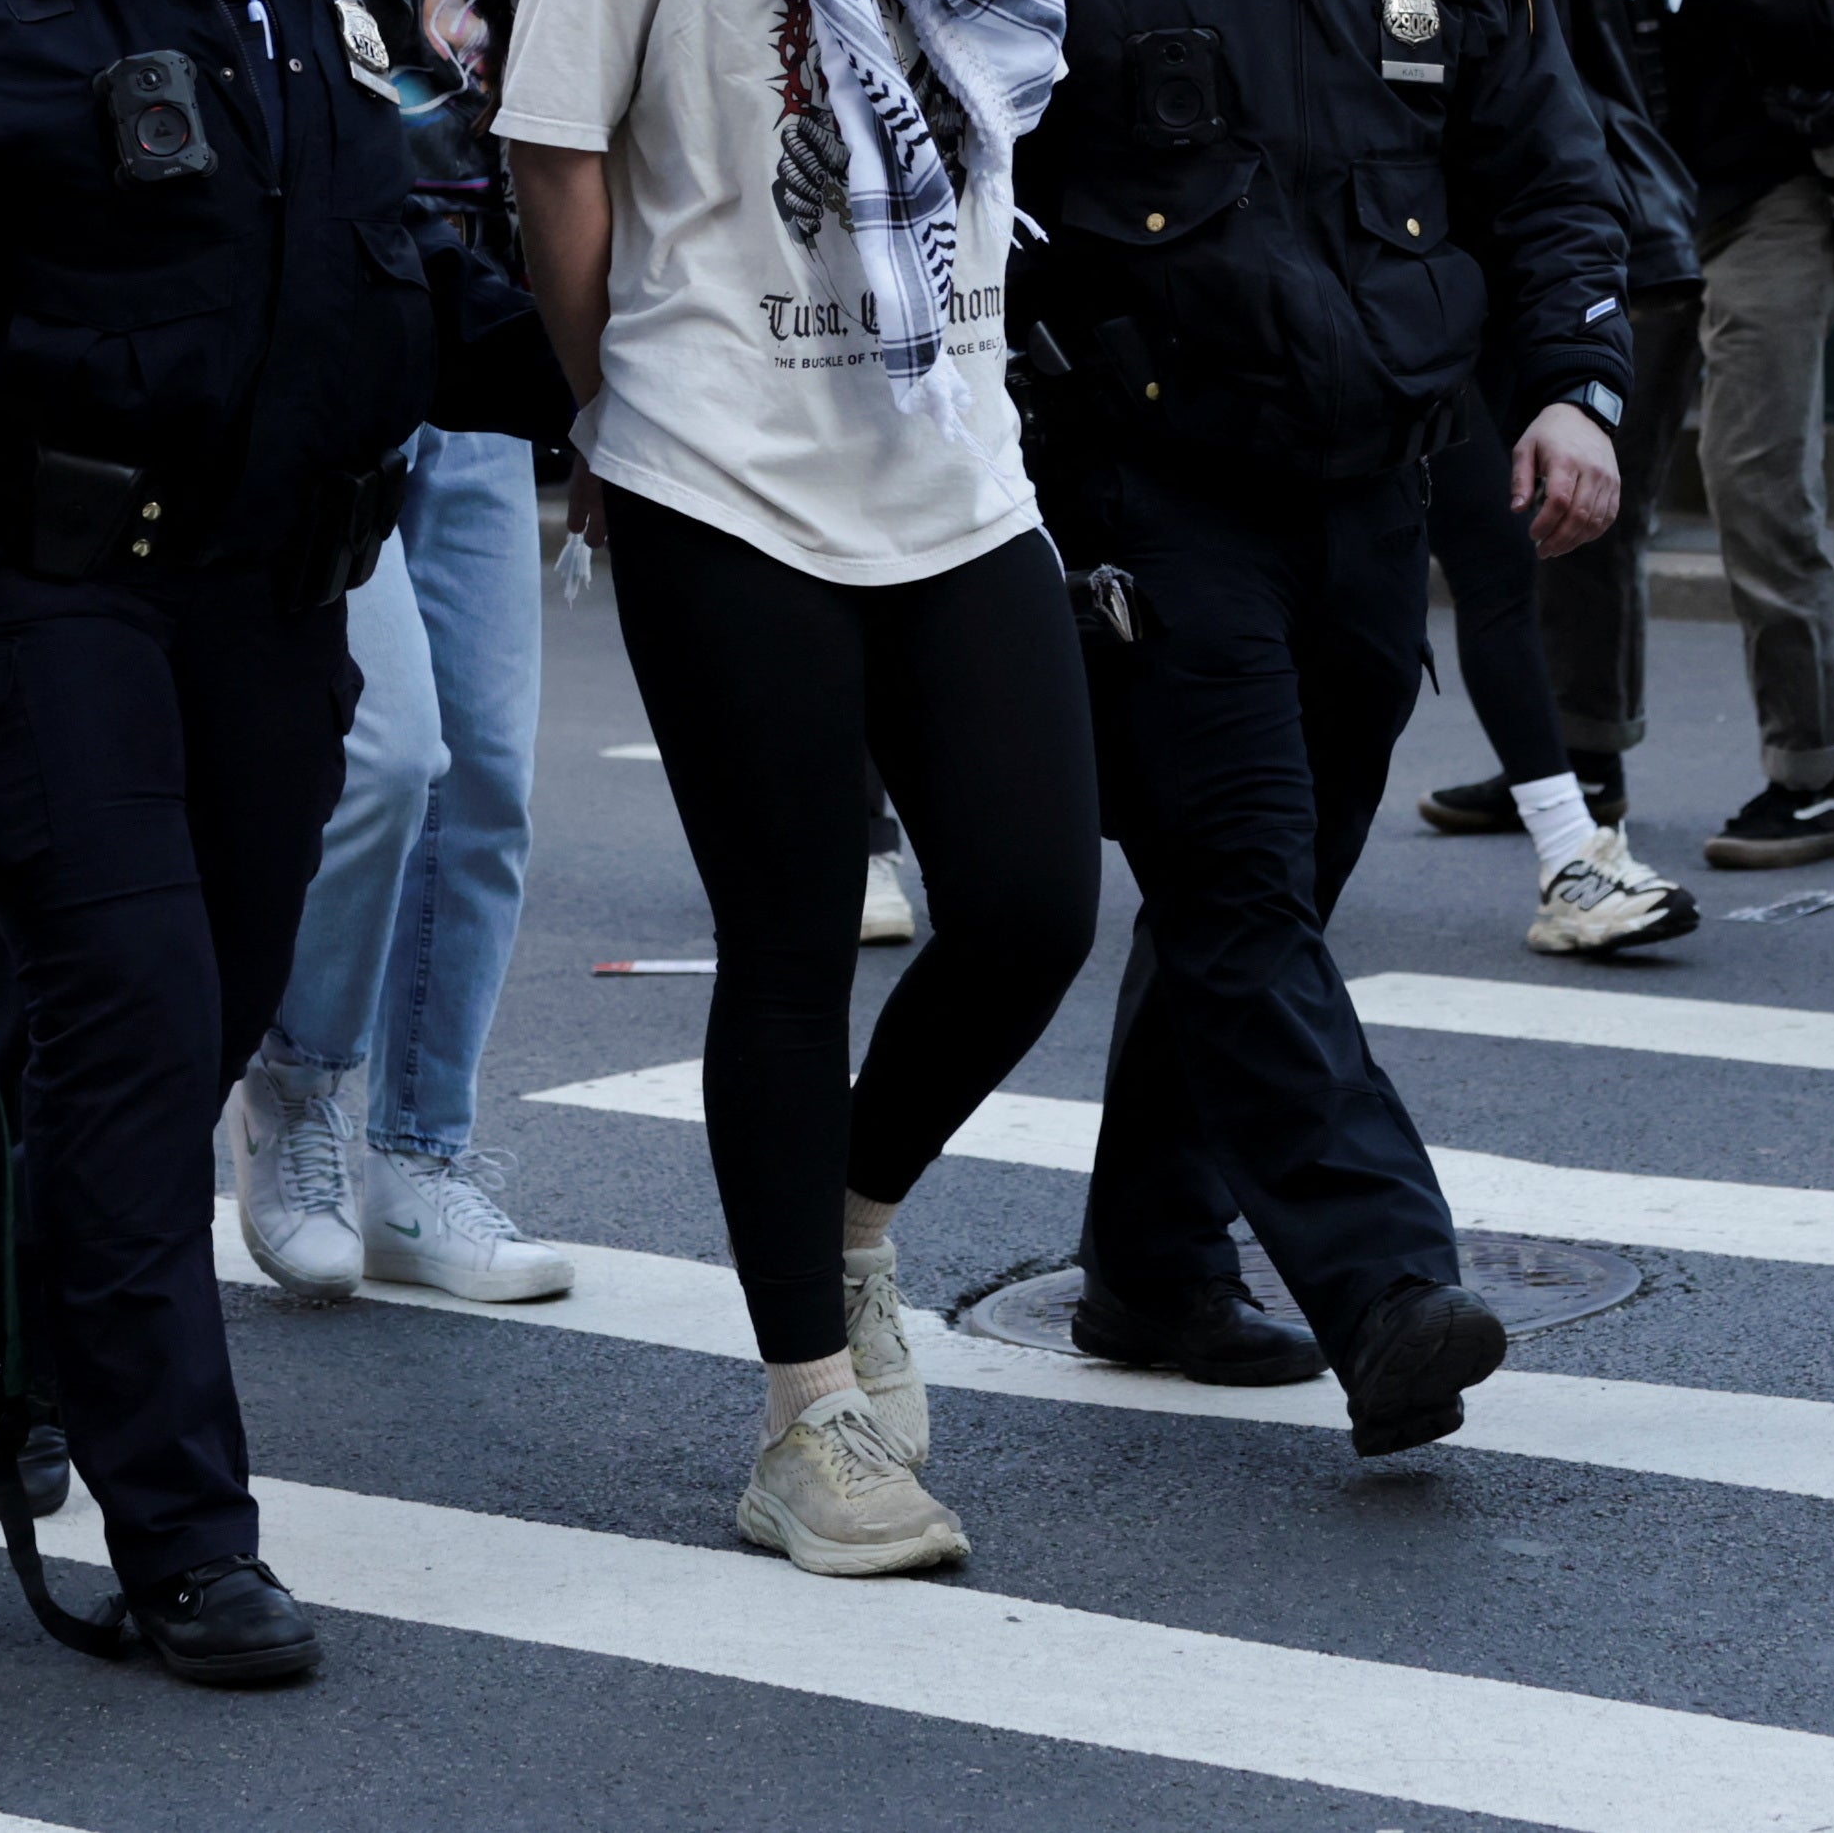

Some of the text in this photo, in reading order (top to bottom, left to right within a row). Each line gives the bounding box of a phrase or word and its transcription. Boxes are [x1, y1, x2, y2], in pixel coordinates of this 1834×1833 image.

[774, 356, 796, 369] THE
[801, 354, 844, 369] BUCKLE
[847, 352, 866, 365] OF
